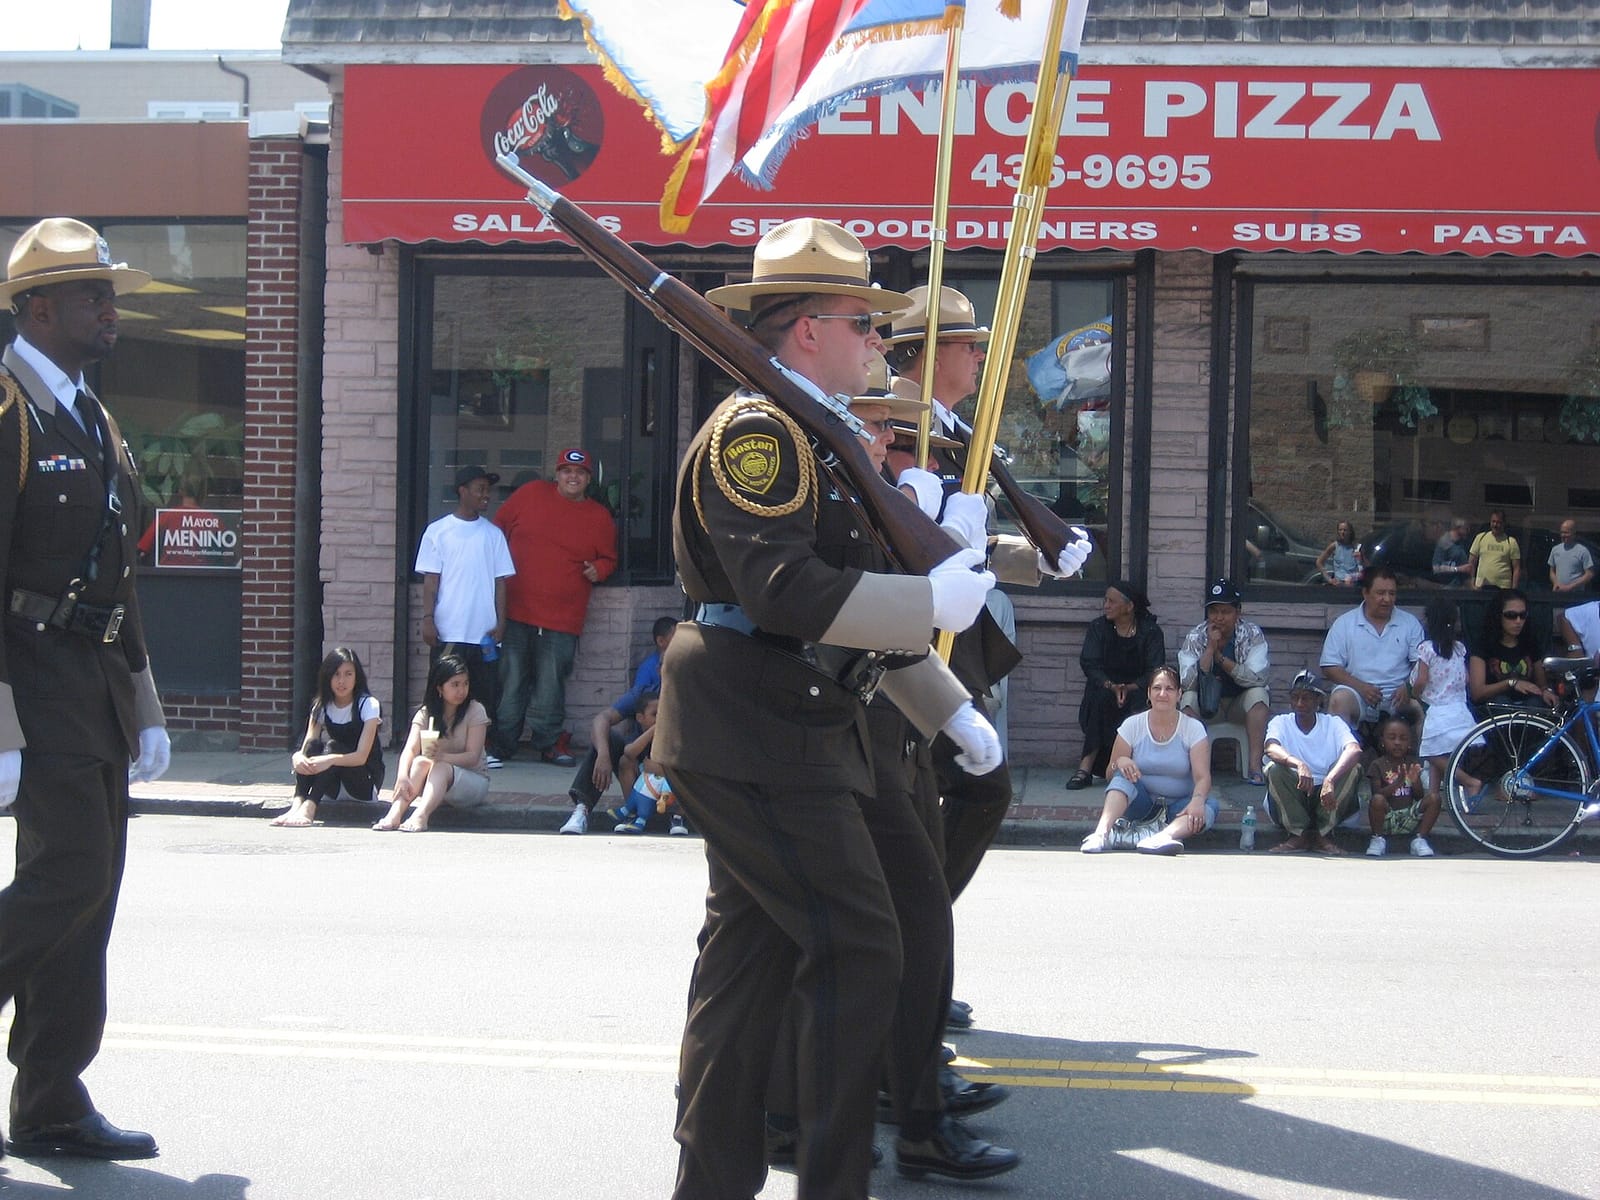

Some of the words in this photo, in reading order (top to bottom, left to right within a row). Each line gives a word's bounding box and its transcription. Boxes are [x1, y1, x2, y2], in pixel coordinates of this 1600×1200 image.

[817, 79, 1110, 137] ENICE
[1143, 80, 1442, 142] PIZZA
[452, 213, 622, 233] SALAS
[729, 218, 933, 238] SEOOD
[1232, 222, 1362, 242] SUBS
[1433, 224, 1587, 245] PASTA
[727, 439, 773, 459] Boston
[163, 529, 237, 548] MENINO
